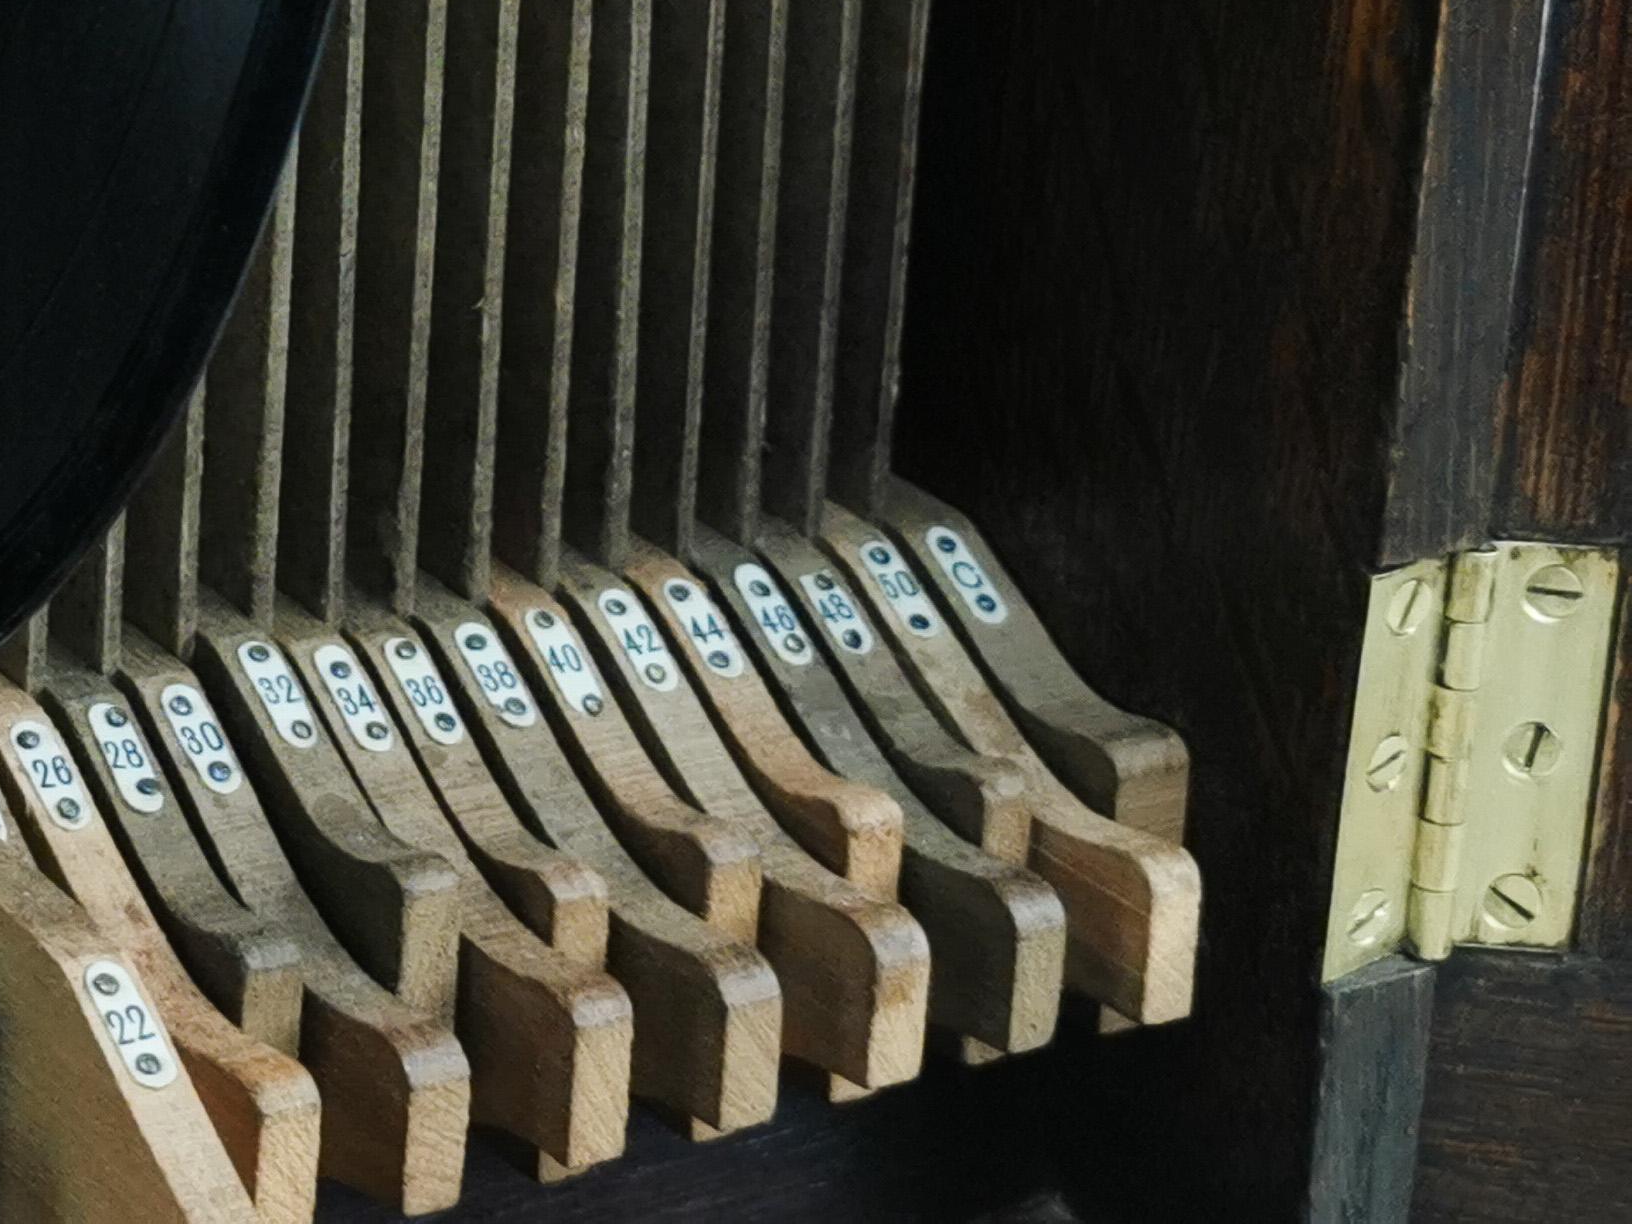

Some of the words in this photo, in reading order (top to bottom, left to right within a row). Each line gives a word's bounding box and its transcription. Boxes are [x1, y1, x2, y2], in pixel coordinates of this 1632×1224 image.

[878, 570, 919, 599] 50
[952, 561, 984, 589] C
[761, 604, 796, 634] 46
[818, 593, 854, 624] 48
[623, 624, 662, 655] 42
[690, 613, 725, 643] 44
[548, 643, 583, 674] 40
[258, 674, 301, 705] 32
[405, 675, 444, 707] 36
[477, 660, 517, 691] 38
[336, 683, 376, 716] 34
[180, 720, 225, 755] 30
[104, 738, 144, 769] 28
[32, 755, 72, 788] 26
[105, 1004, 155, 1045] 22
